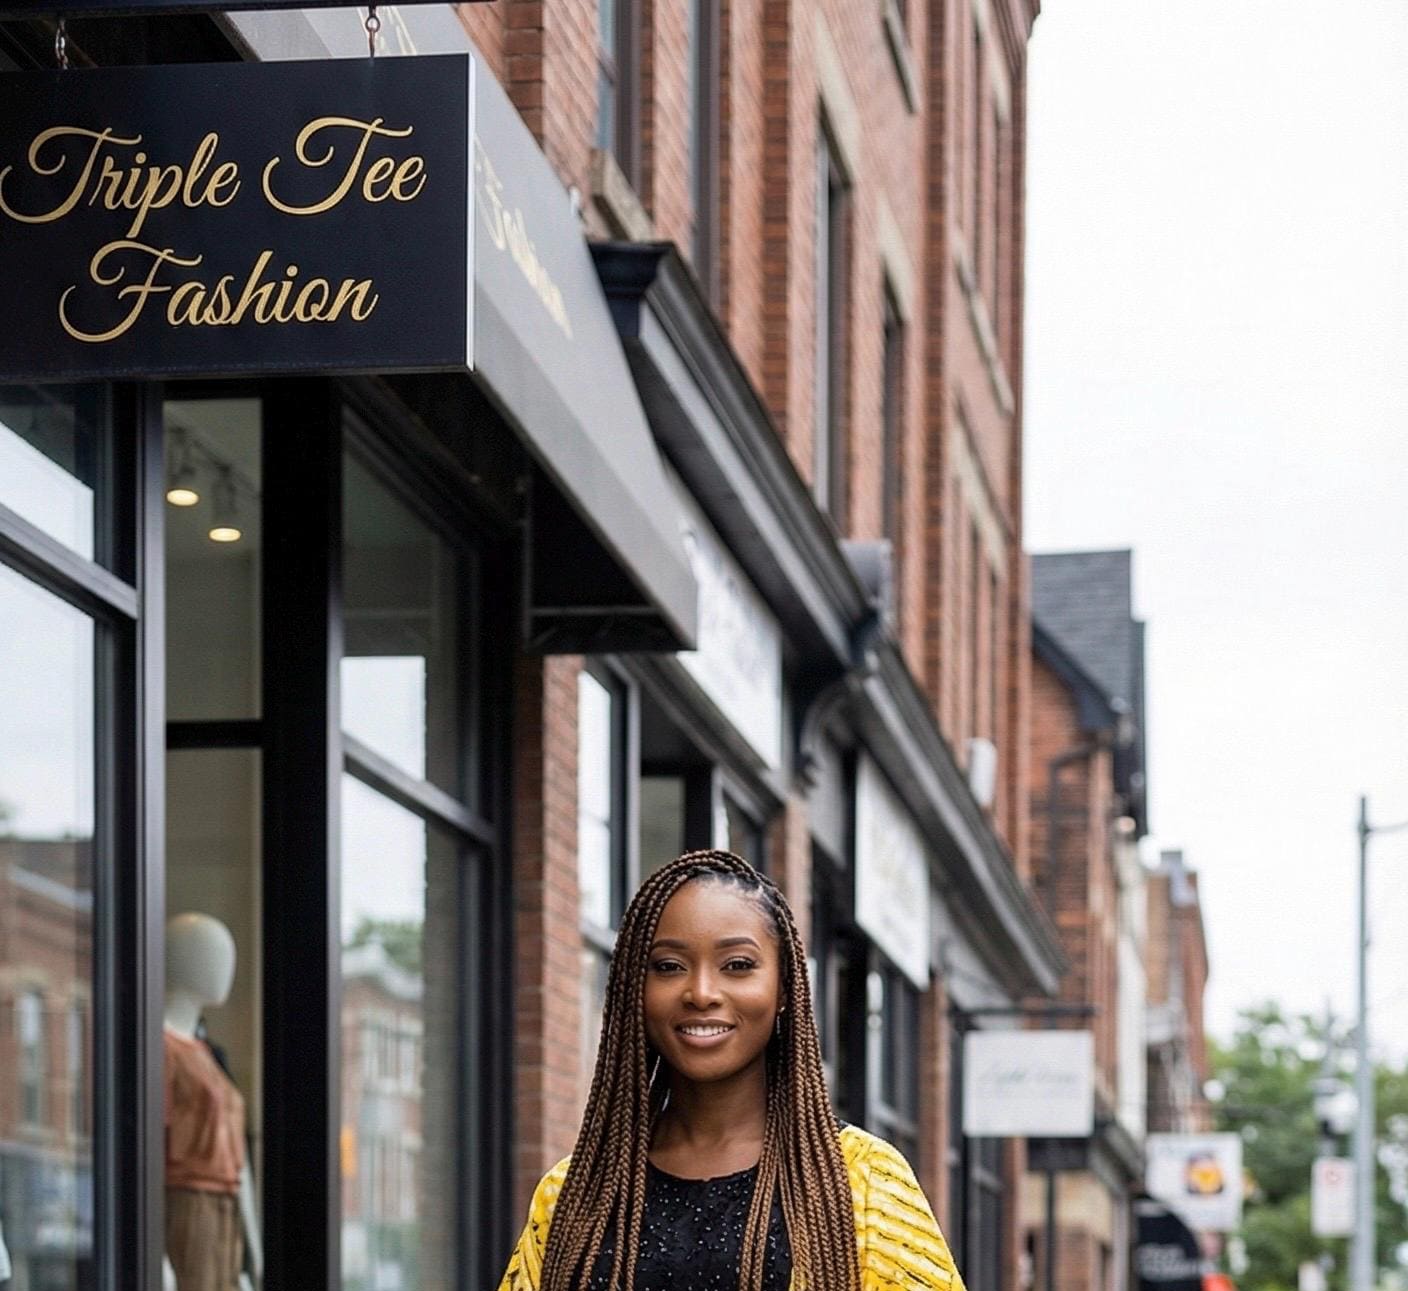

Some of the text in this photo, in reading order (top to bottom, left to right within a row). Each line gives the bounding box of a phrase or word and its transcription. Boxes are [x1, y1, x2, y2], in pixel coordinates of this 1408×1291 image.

[0, 116, 427, 238] Triple Tee
[59, 240, 379, 342] Fashion
